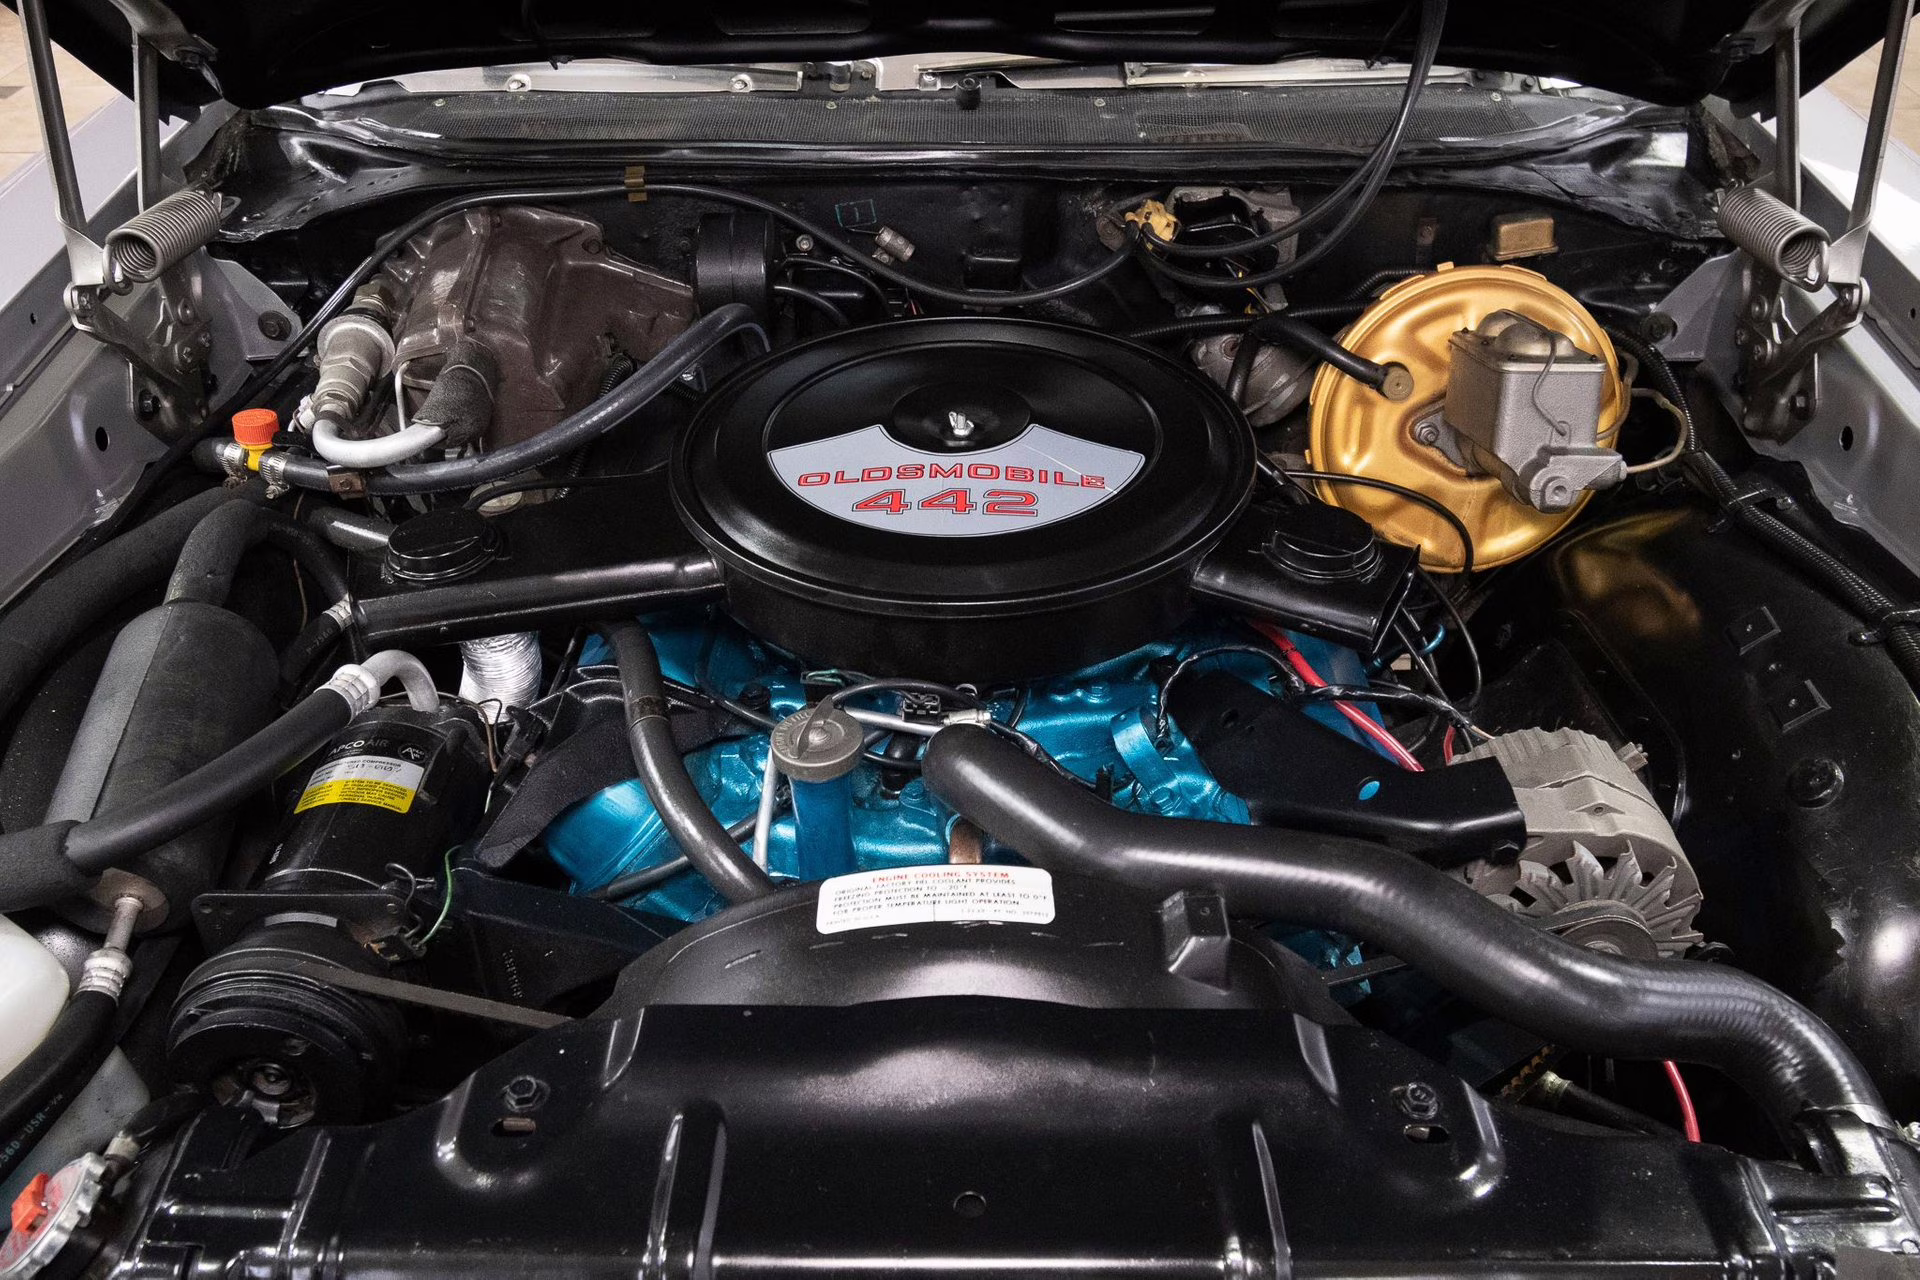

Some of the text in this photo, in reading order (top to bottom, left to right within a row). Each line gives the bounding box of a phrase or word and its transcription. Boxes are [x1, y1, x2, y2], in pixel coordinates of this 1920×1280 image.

[797, 463, 1106, 490] OLDSMOBILE
[851, 487, 1039, 517] 442
[328, 740, 365, 756] APCO
[872, 875, 907, 883] ENGINE
[914, 872, 961, 880] COOLING
[834, 892, 871, 902] FREEZING
[875, 887, 923, 896] PROTECTION
[835, 886, 872, 896] ORIGINAL
[876, 881, 911, 889] FACTORY
[832, 908, 849, 916] FOR
[852, 904, 882, 913] PROPER
[886, 899, 941, 908] TEMPERATURE
[833, 897, 881, 908] PROTECTION
[992, 891, 1016, 899] LEAST
